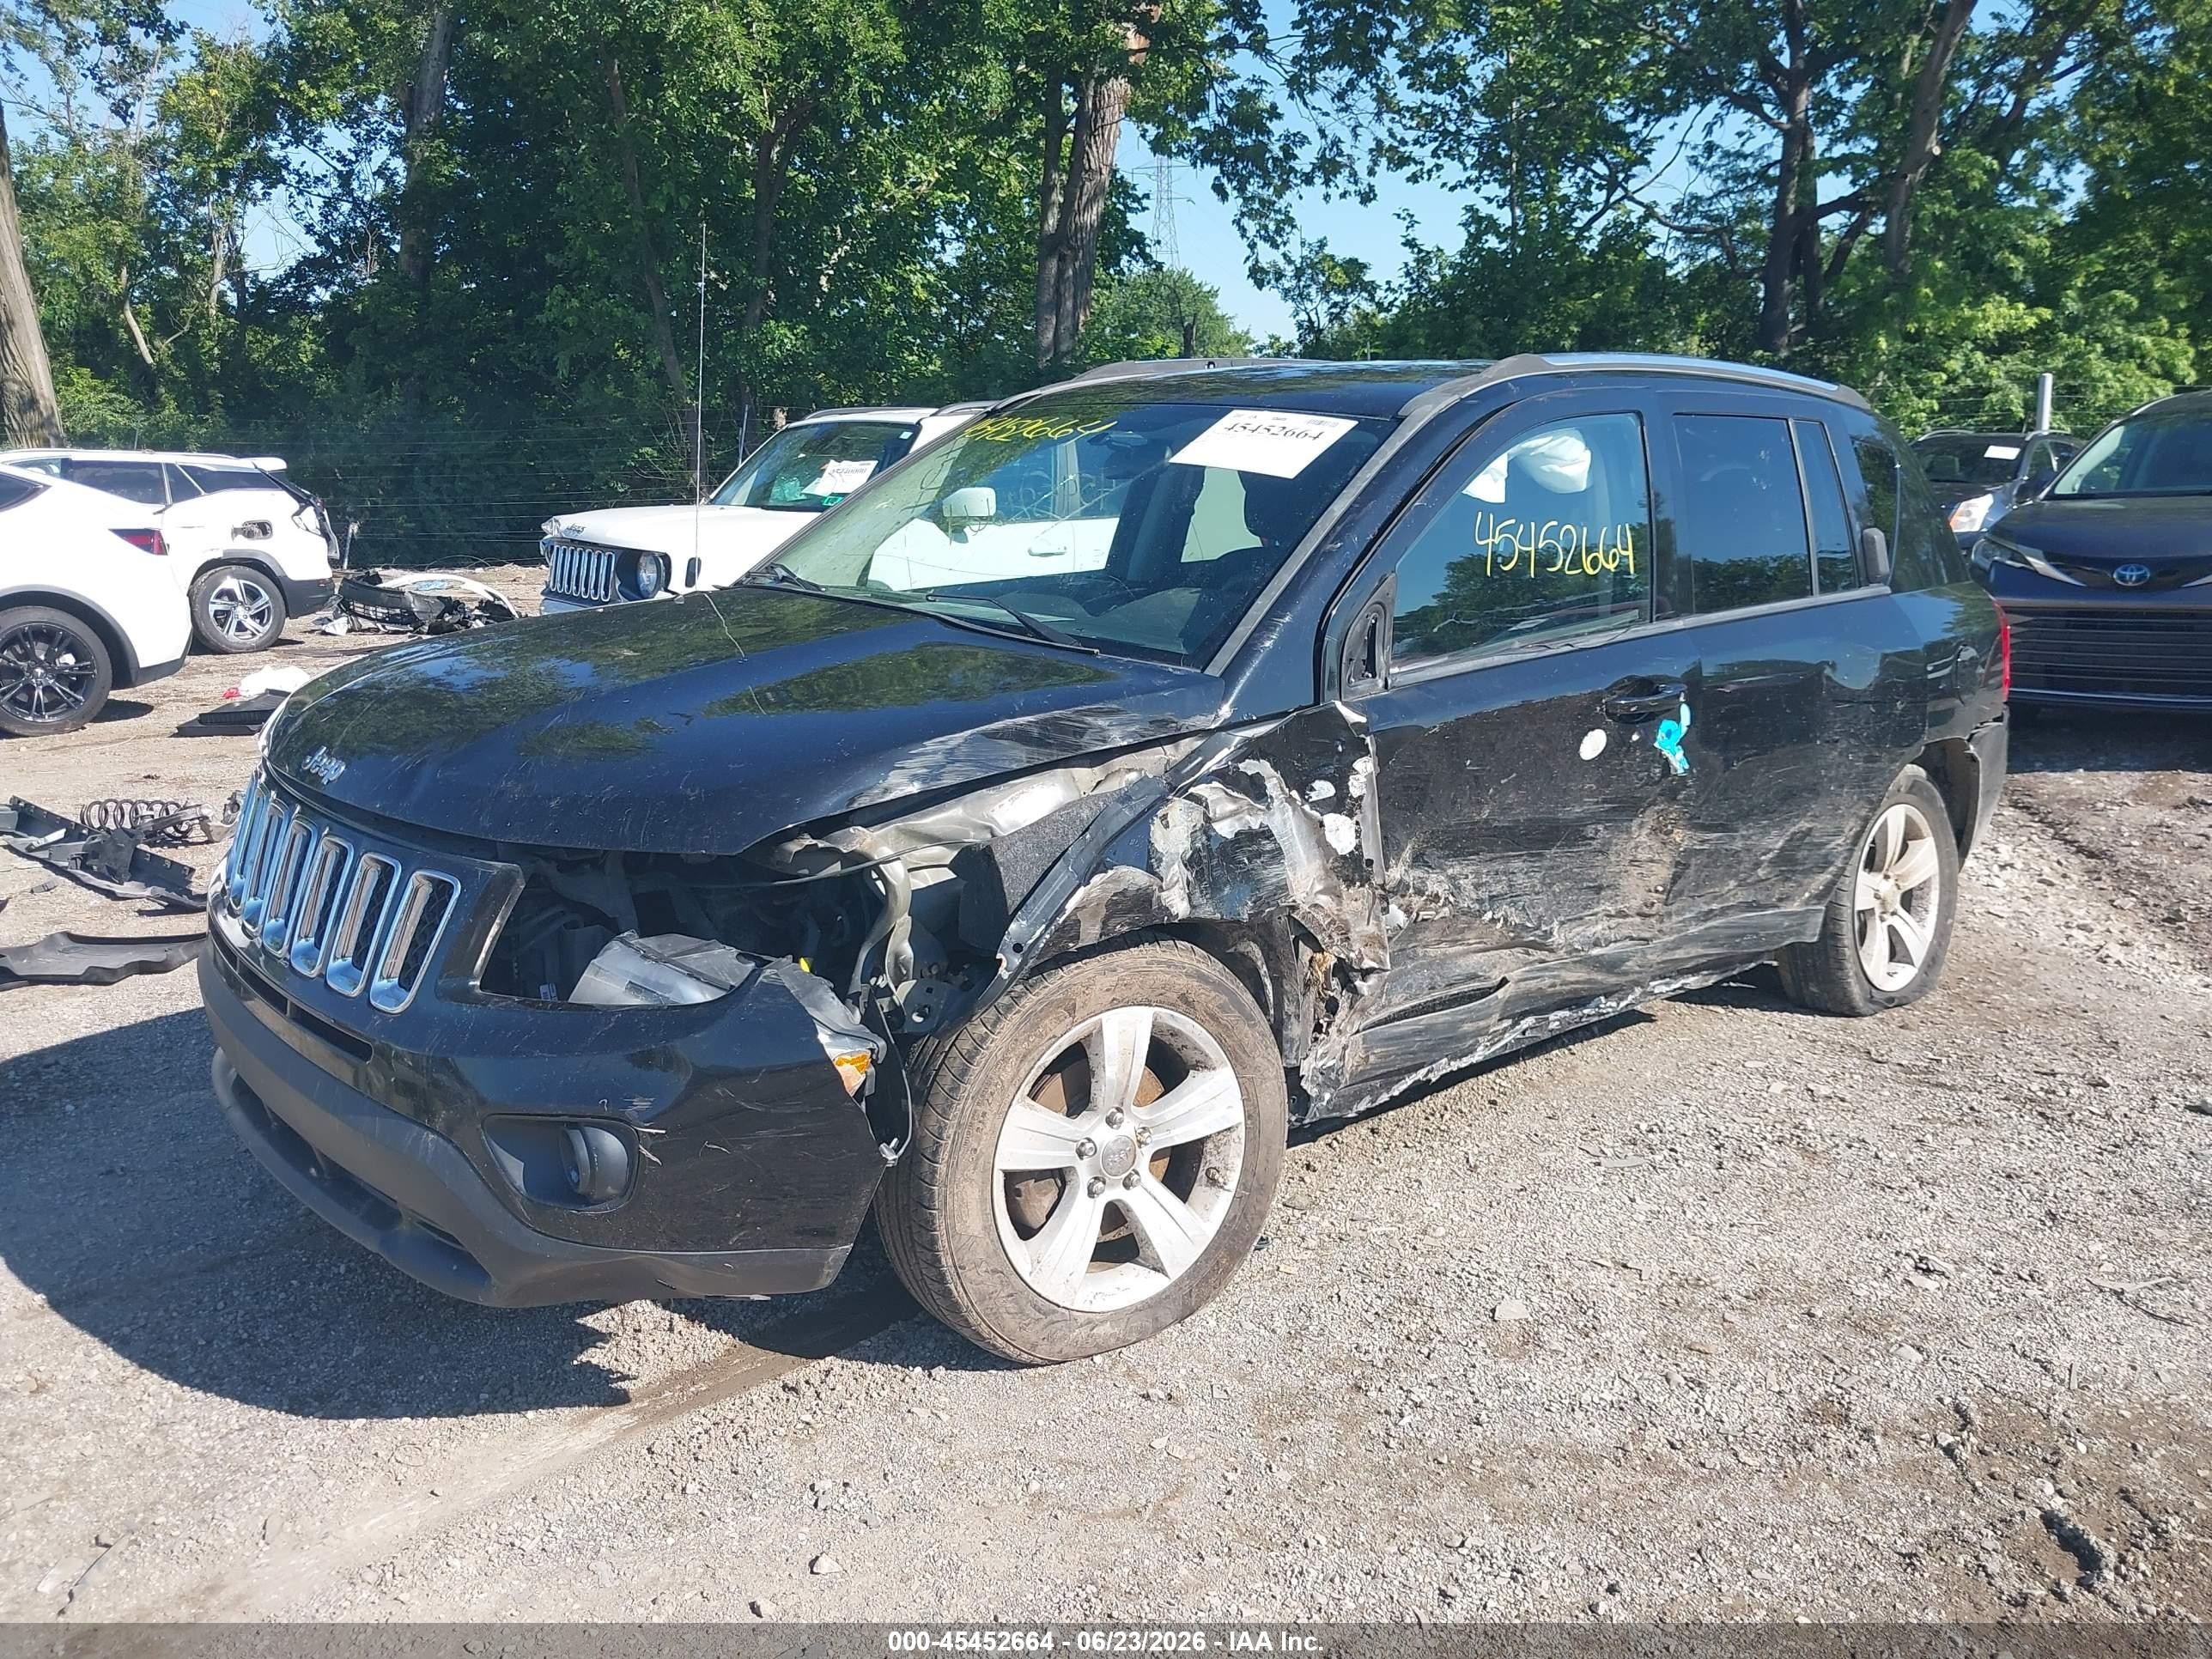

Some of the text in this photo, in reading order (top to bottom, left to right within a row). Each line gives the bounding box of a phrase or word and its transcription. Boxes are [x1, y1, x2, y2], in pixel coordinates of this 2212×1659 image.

[1224, 422, 1325, 441] 45452664
[1474, 511, 1635, 578] 45452664
[301, 744, 346, 785] Jeep
